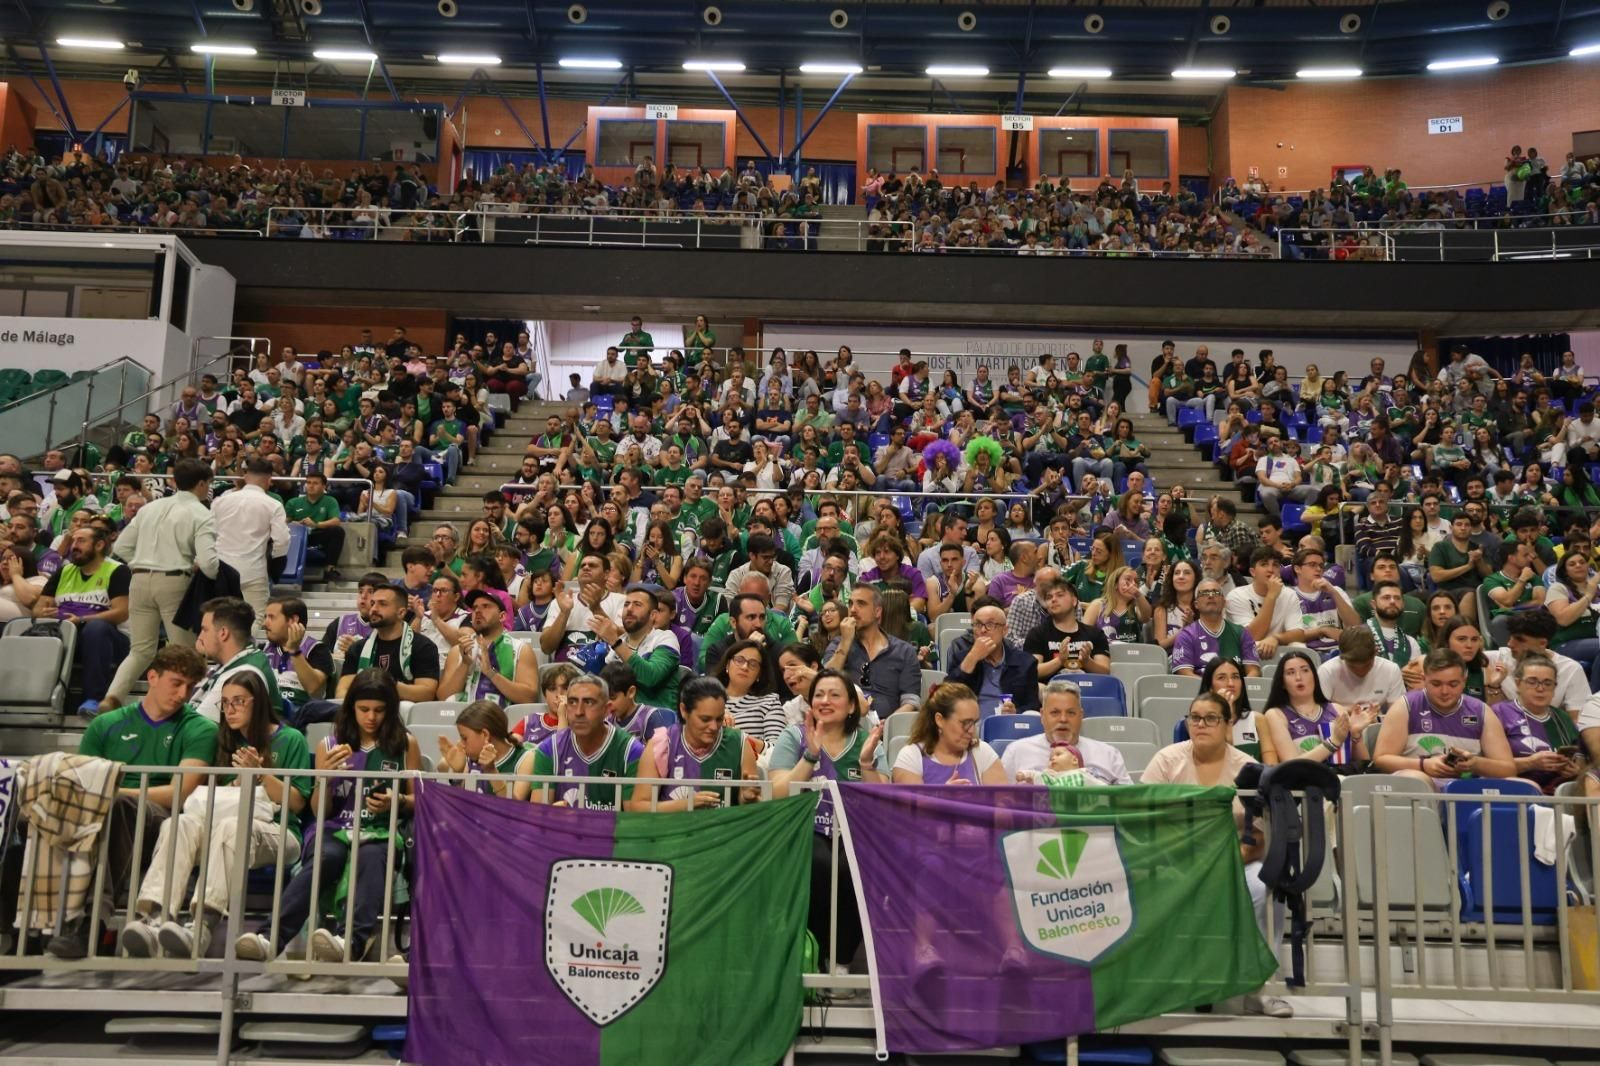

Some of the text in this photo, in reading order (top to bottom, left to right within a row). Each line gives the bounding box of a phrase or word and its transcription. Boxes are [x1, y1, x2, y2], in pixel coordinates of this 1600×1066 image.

[282, 97, 295, 105] B3
[656, 111, 668, 119] B4
[1430, 117, 1460, 125] SECTOR
[0, 330, 75, 346] de Málaga
[1031, 880, 1113, 907] Fundación
[1046, 901, 1105, 923] Unicaja
[1037, 915, 1120, 940] Baloncesto
[569, 941, 640, 965] Unicaja
[568, 965, 640, 980] Baloncesto
